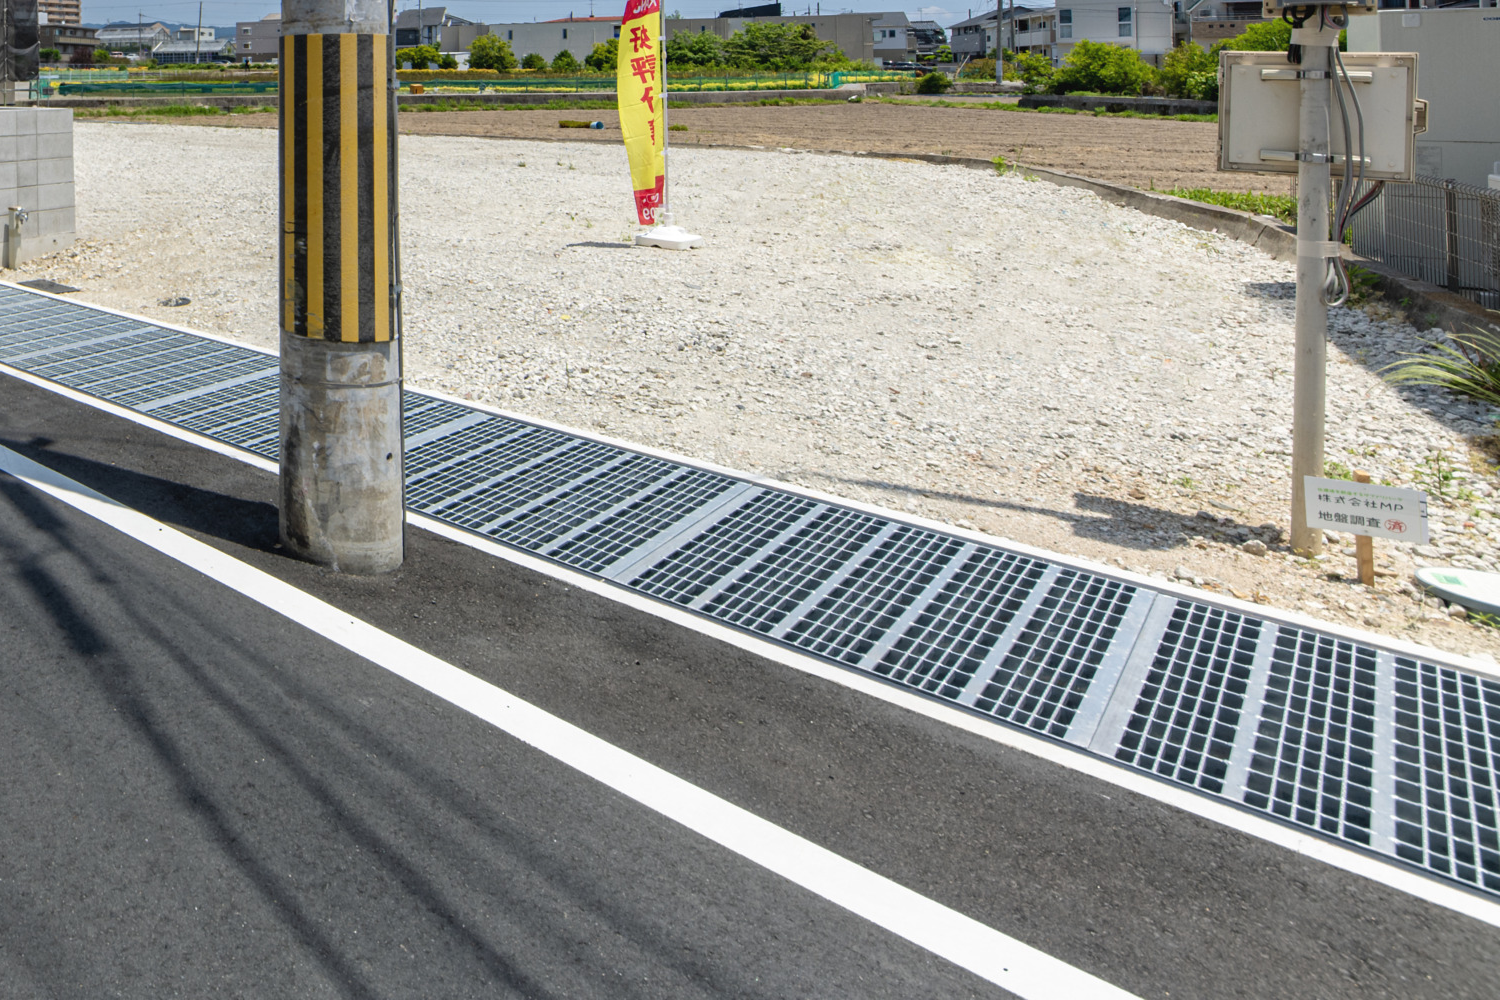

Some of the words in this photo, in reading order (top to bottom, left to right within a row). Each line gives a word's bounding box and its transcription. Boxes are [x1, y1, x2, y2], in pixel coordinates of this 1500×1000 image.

[1318, 494, 1404, 511] 株式会社MP
[1318, 510, 1381, 529] 地盤調査
